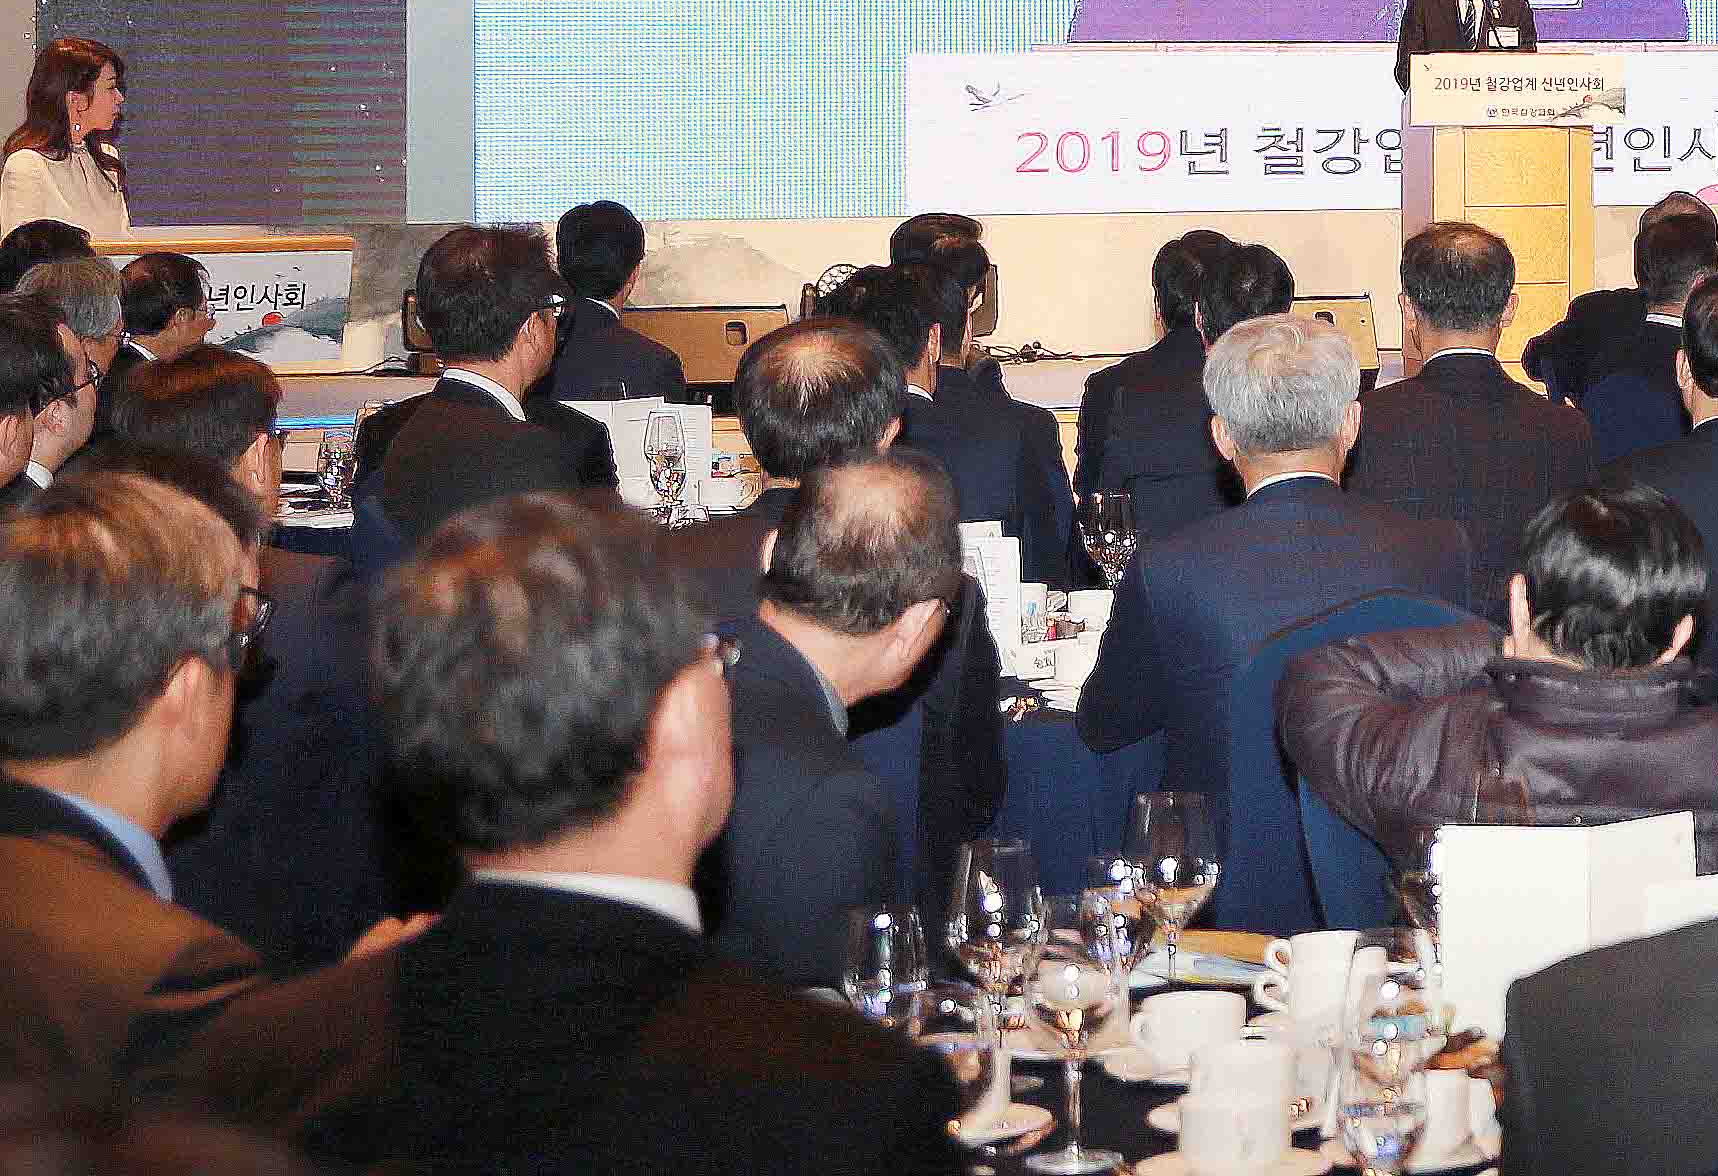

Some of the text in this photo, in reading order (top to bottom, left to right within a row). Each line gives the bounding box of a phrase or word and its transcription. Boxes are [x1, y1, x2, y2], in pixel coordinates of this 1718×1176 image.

[1436, 76, 1604, 92] 2019년 철강업계 신년인사회
[1015, 127, 1230, 176] 2019년
